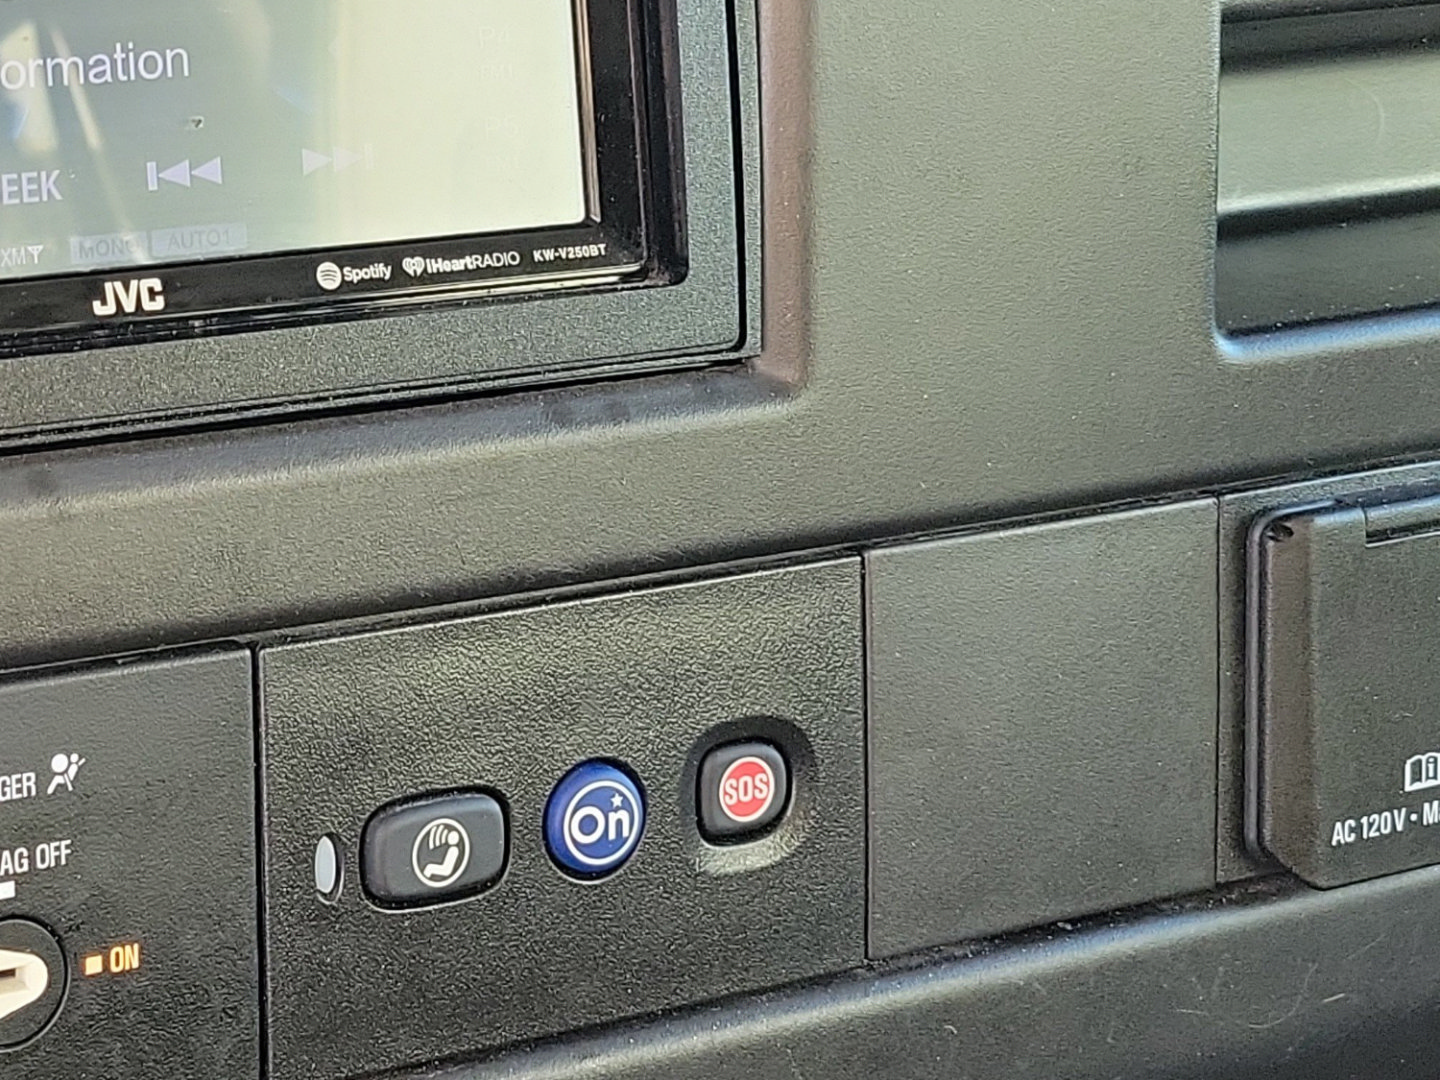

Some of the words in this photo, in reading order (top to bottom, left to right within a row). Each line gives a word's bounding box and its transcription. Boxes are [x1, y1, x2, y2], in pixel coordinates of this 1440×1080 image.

[78, 238, 140, 260] MONO
[167, 228, 232, 252] AUTO1
[532, 243, 607, 263] KW-V250BT
[343, 262, 393, 284] Spotify
[92, 277, 166, 317] JVC
[724, 772, 769, 806] SOS
[1331, 819, 1356, 846] AC
[1360, 807, 1407, 840] 120V
[1422, 800, 1440, 826] M
[35, 839, 73, 870] OFF
[109, 941, 140, 974] ON
